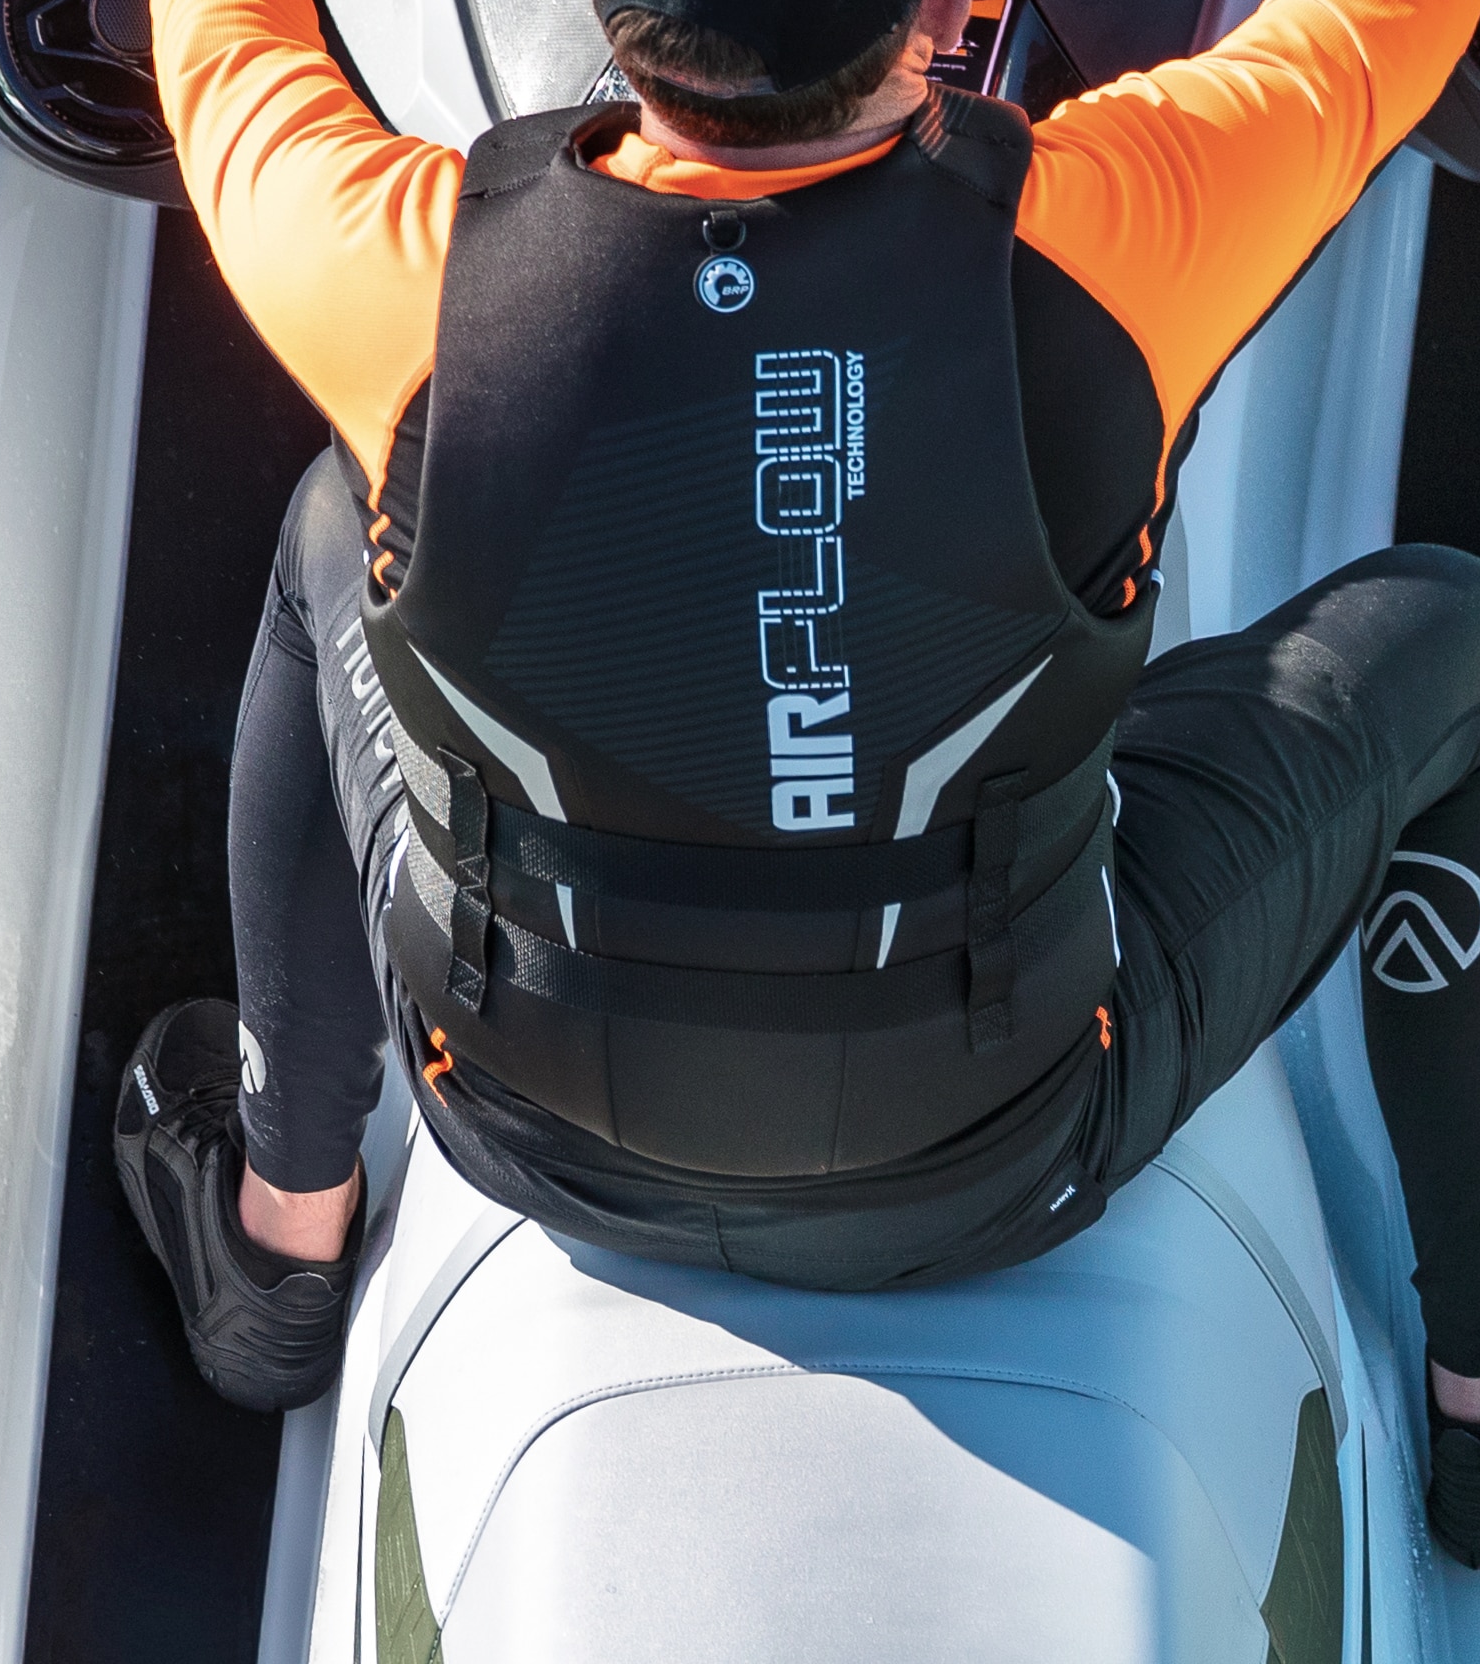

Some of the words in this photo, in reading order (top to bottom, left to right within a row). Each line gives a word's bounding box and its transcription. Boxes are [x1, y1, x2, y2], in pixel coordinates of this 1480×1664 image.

[722, 285, 750, 296] BRP
[846, 350, 866, 501] TECHNOLOGY
[755, 349, 855, 831] AIRFLOW
